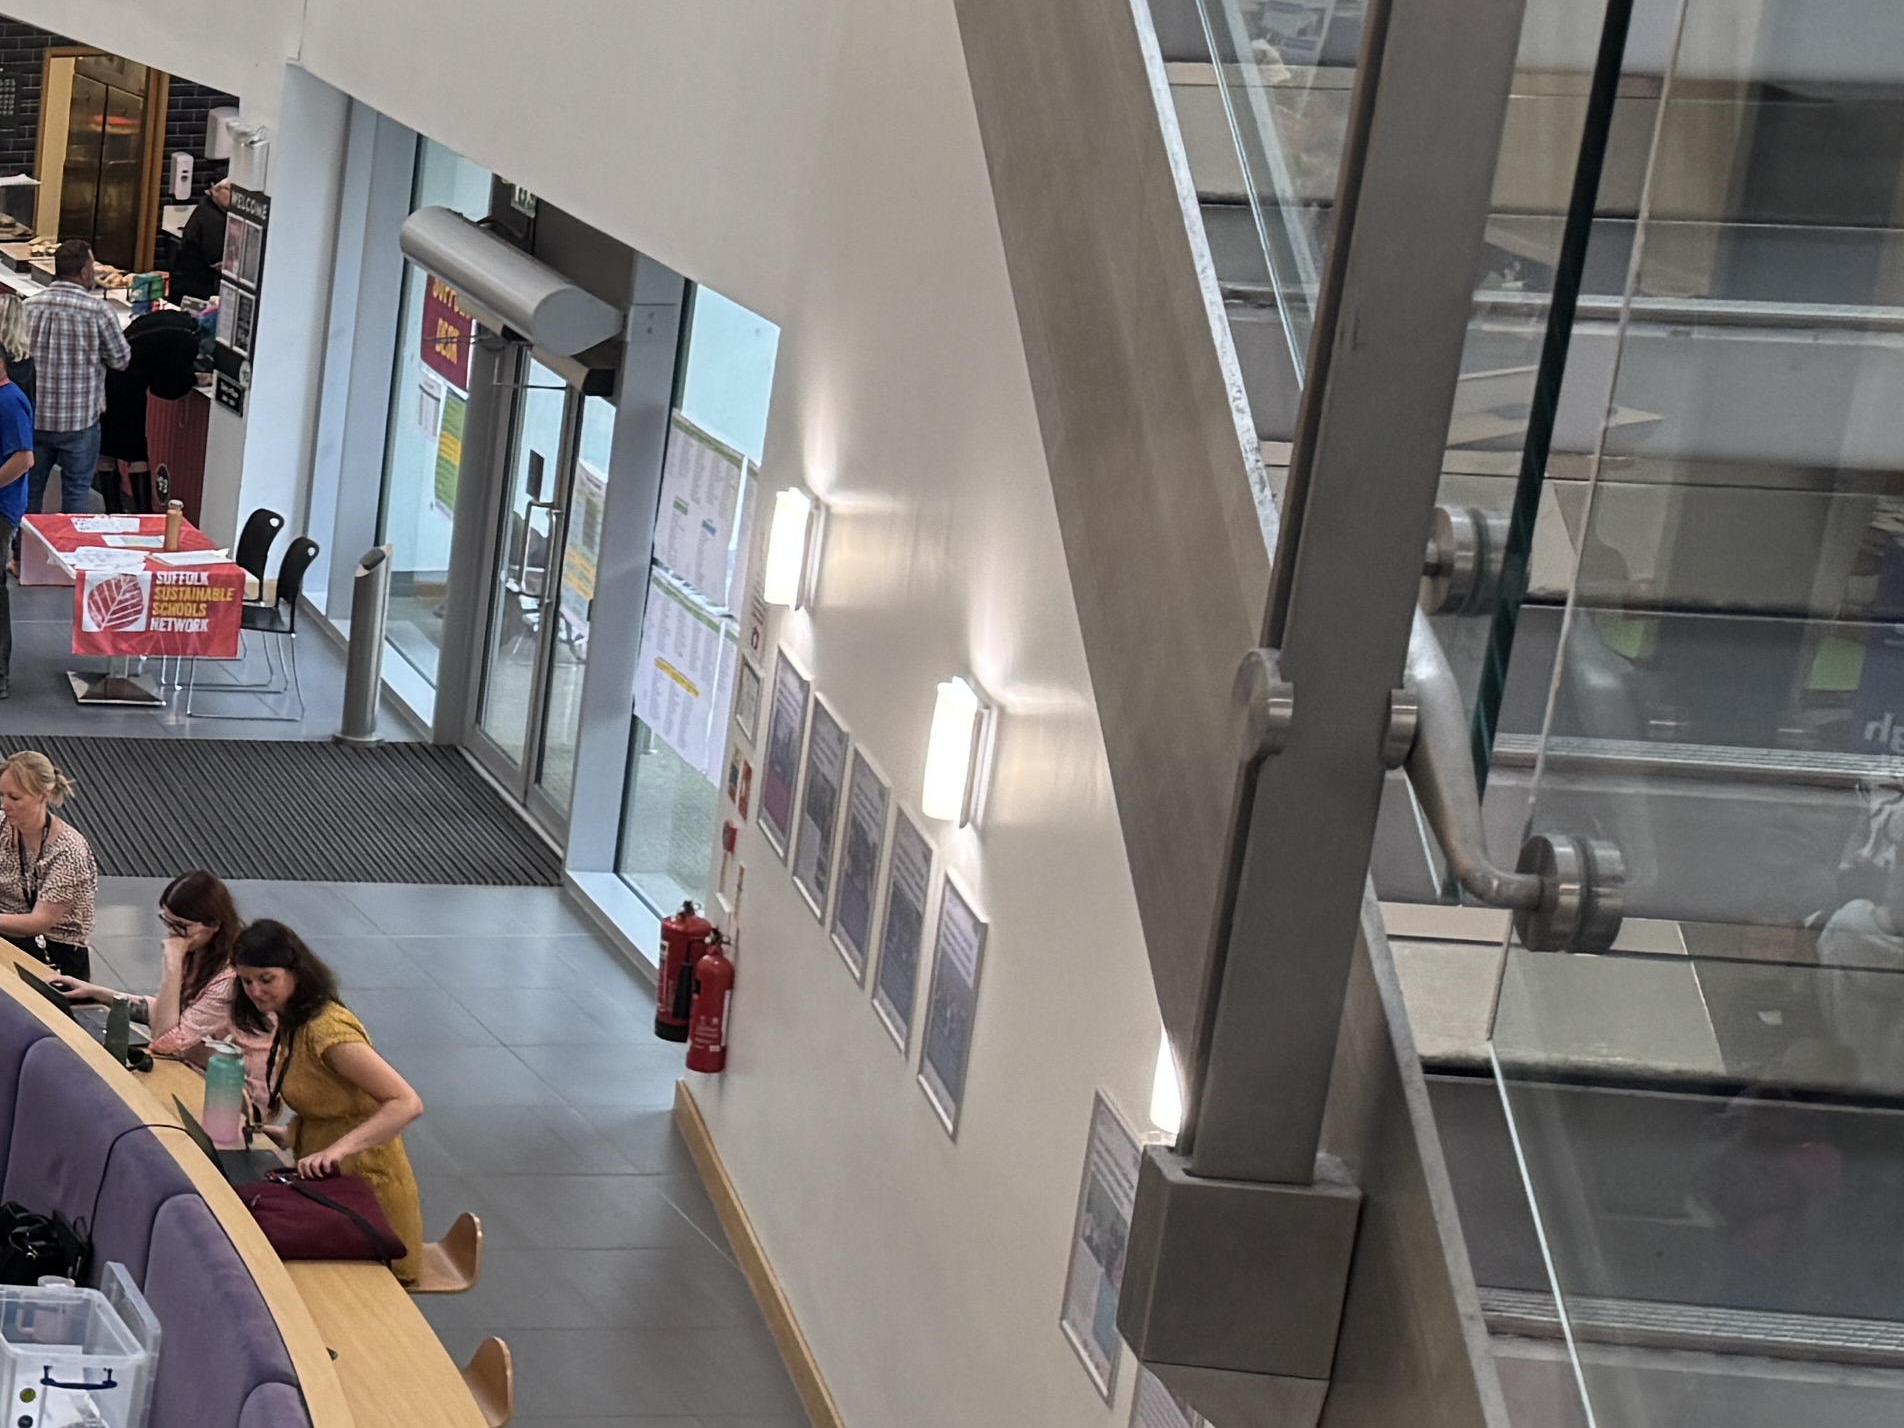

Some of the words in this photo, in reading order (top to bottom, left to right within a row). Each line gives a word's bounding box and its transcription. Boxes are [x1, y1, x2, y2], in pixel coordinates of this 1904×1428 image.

[231, 192, 267, 220] WELCOME
[156, 572, 209, 585] SUFFOLK
[154, 587, 235, 601] SUSTAINABLE
[152, 604, 207, 616] SCHOOLS
[150, 618, 209, 632] NETWORK
